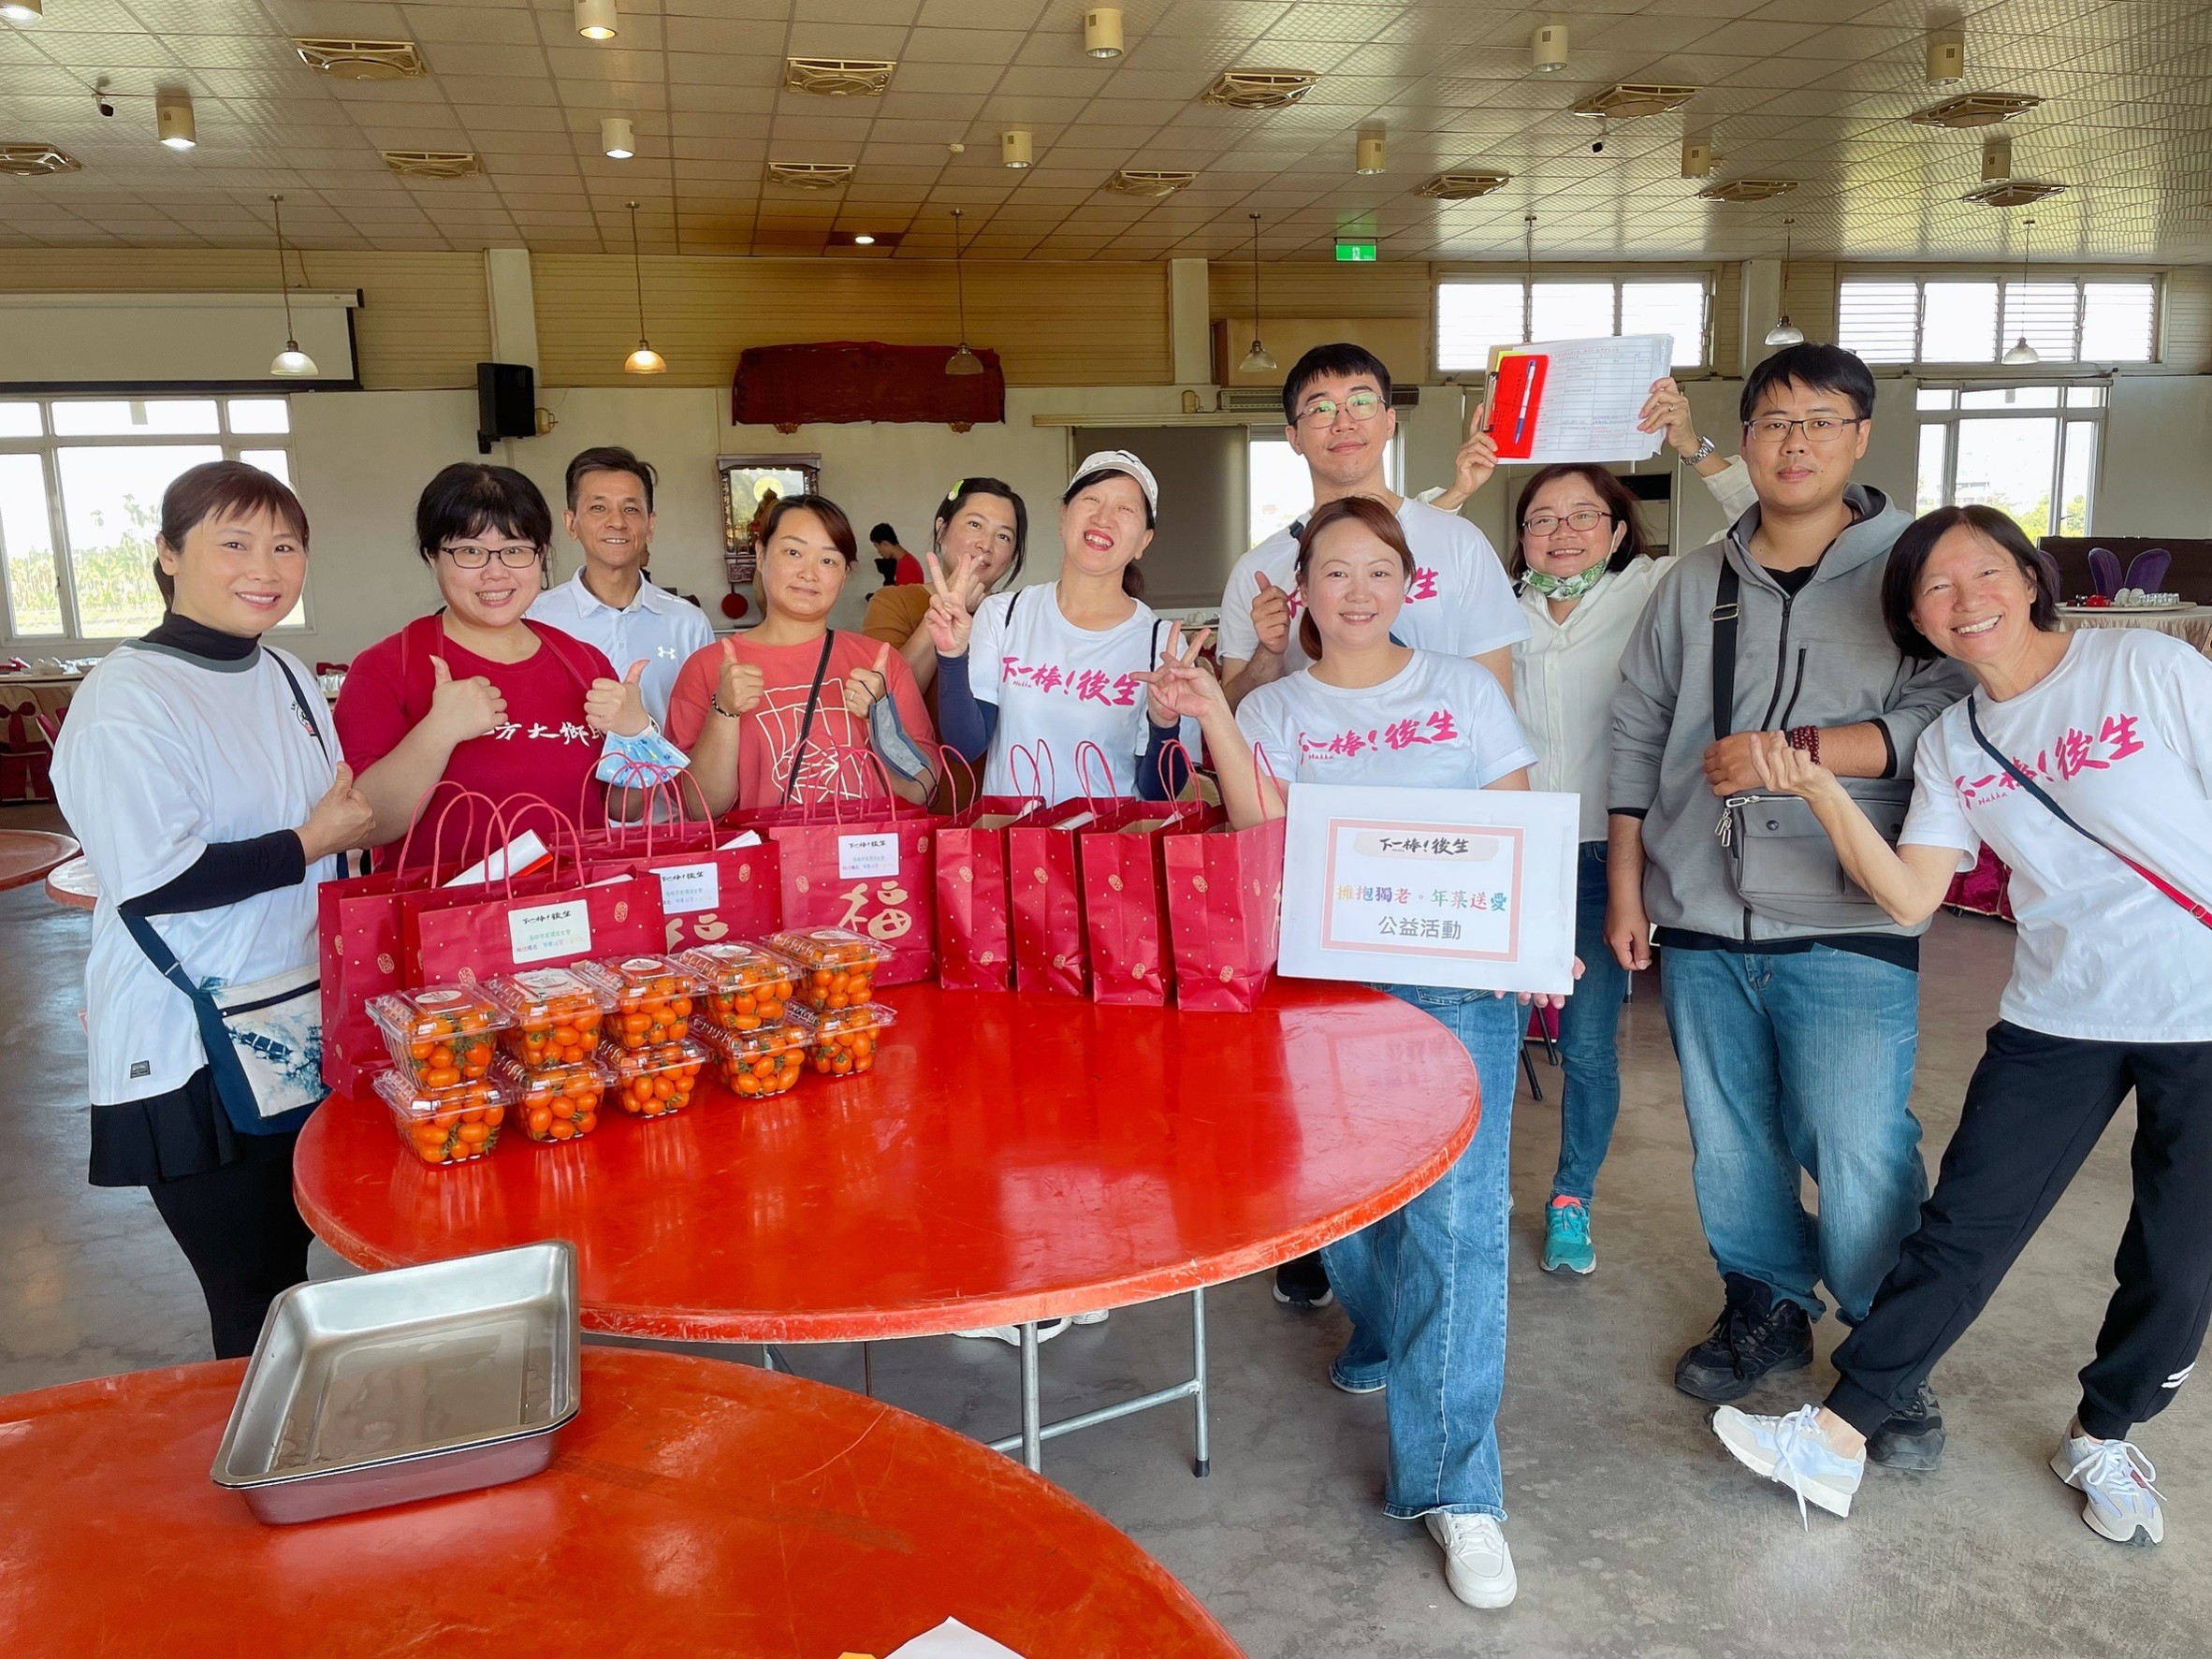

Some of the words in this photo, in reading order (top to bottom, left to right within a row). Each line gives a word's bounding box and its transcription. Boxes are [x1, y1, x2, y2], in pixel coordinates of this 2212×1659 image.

[1978, 792, 2007, 806] Hakka
[1379, 837, 1469, 855] 下一棒!後生
[838, 880, 912, 939] 福
[1378, 915, 1462, 940] 公益活動
